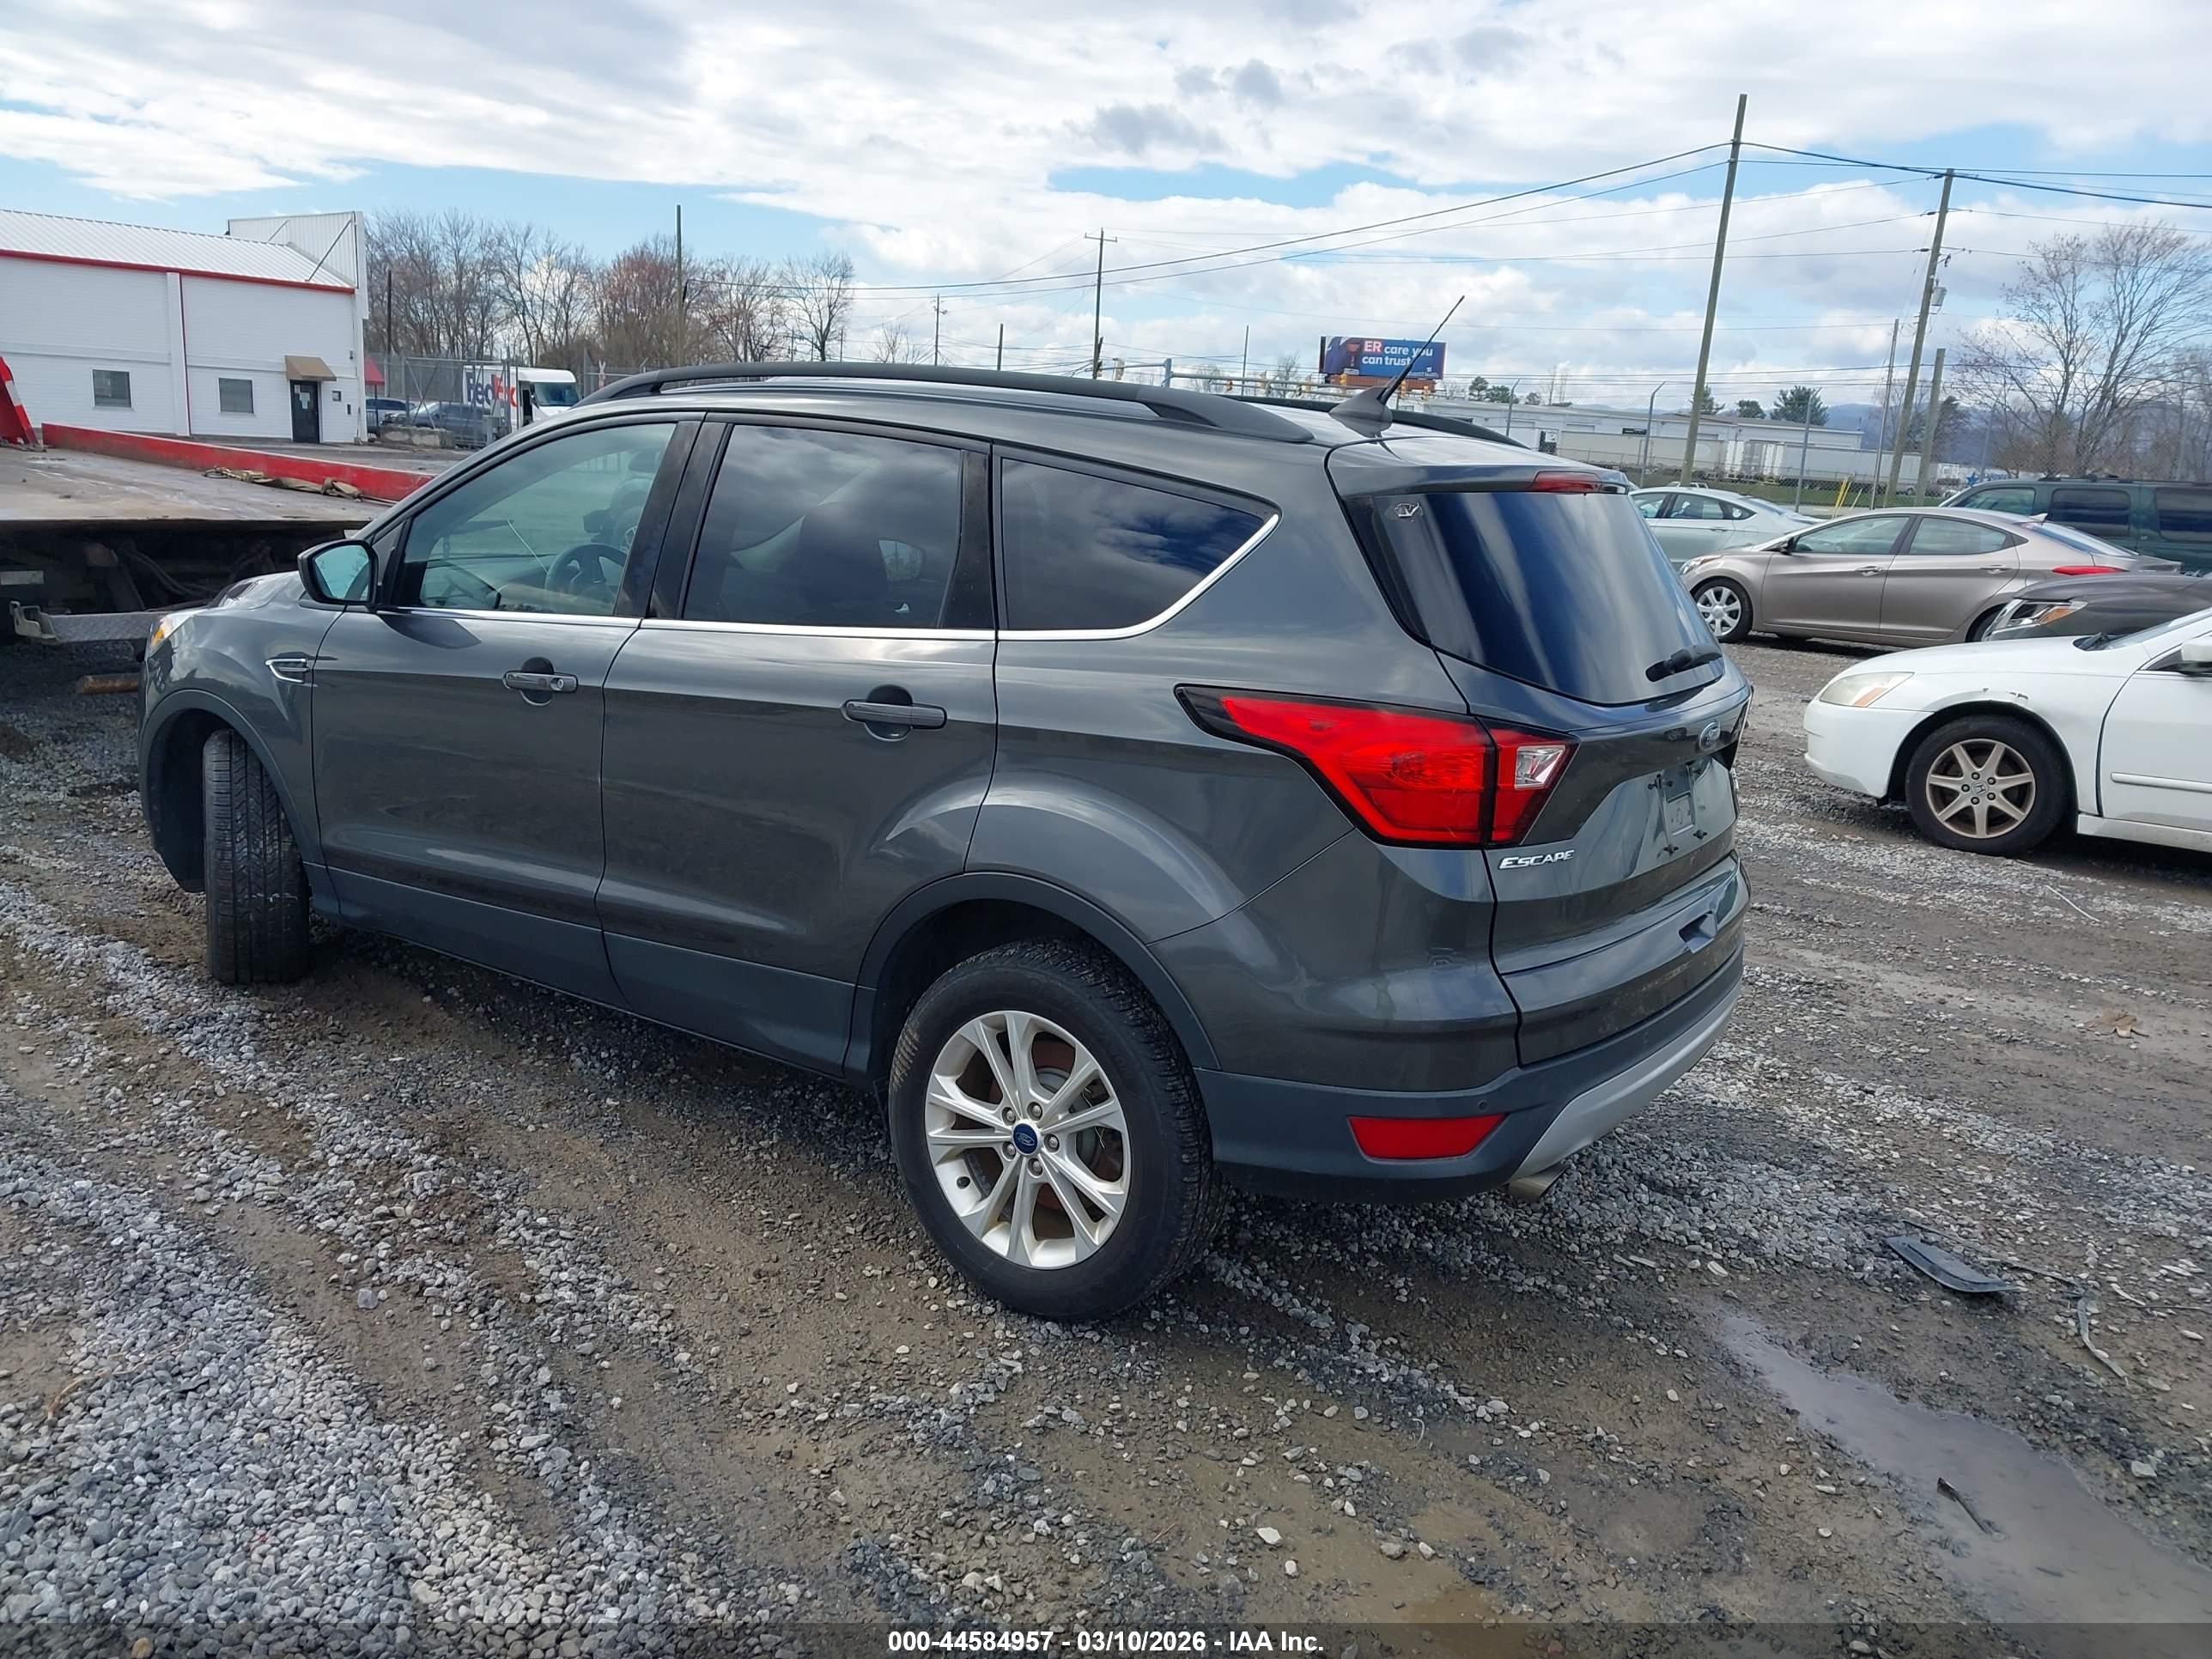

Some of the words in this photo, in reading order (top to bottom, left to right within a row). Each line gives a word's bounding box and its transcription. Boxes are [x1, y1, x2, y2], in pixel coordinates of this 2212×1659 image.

[1364, 341, 1382, 352] ER
[1384, 346, 1409, 355] care
[1362, 356, 1382, 365] can
[1499, 849, 1575, 869] ESCAPE
